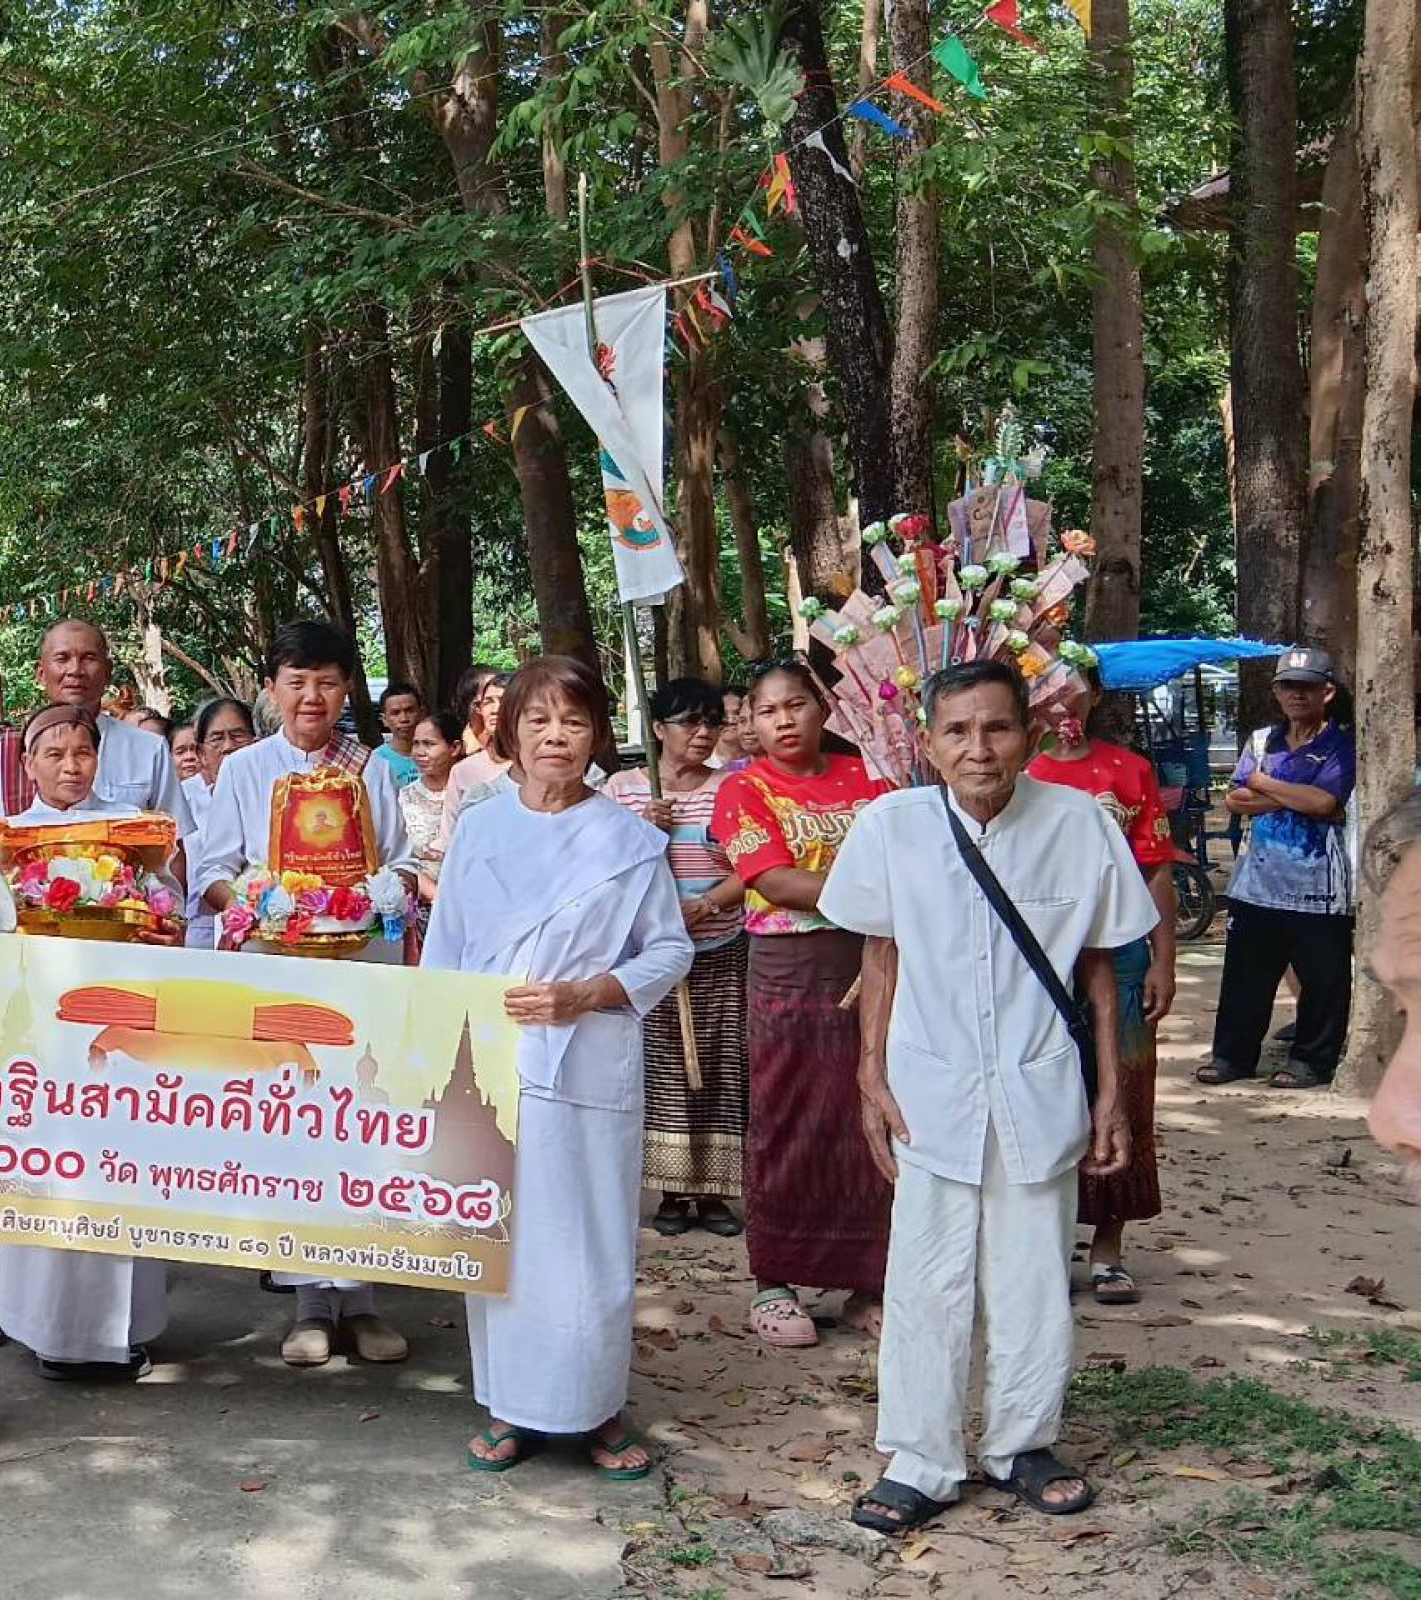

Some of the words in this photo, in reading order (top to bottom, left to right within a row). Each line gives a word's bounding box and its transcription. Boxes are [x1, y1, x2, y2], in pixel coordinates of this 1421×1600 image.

[99, 1149, 138, 1184] วัด
[149, 1160, 324, 1202] พุทธศักราช
[339, 1171, 493, 1222] ๒๕๖๘
[129, 1224, 230, 1250] บูชาธรรม
[238, 1239, 270, 1257] ๘๑
[278, 1234, 295, 1258] ปี
[302, 1241, 481, 1279] หลวงพ่อธัมมชโย
